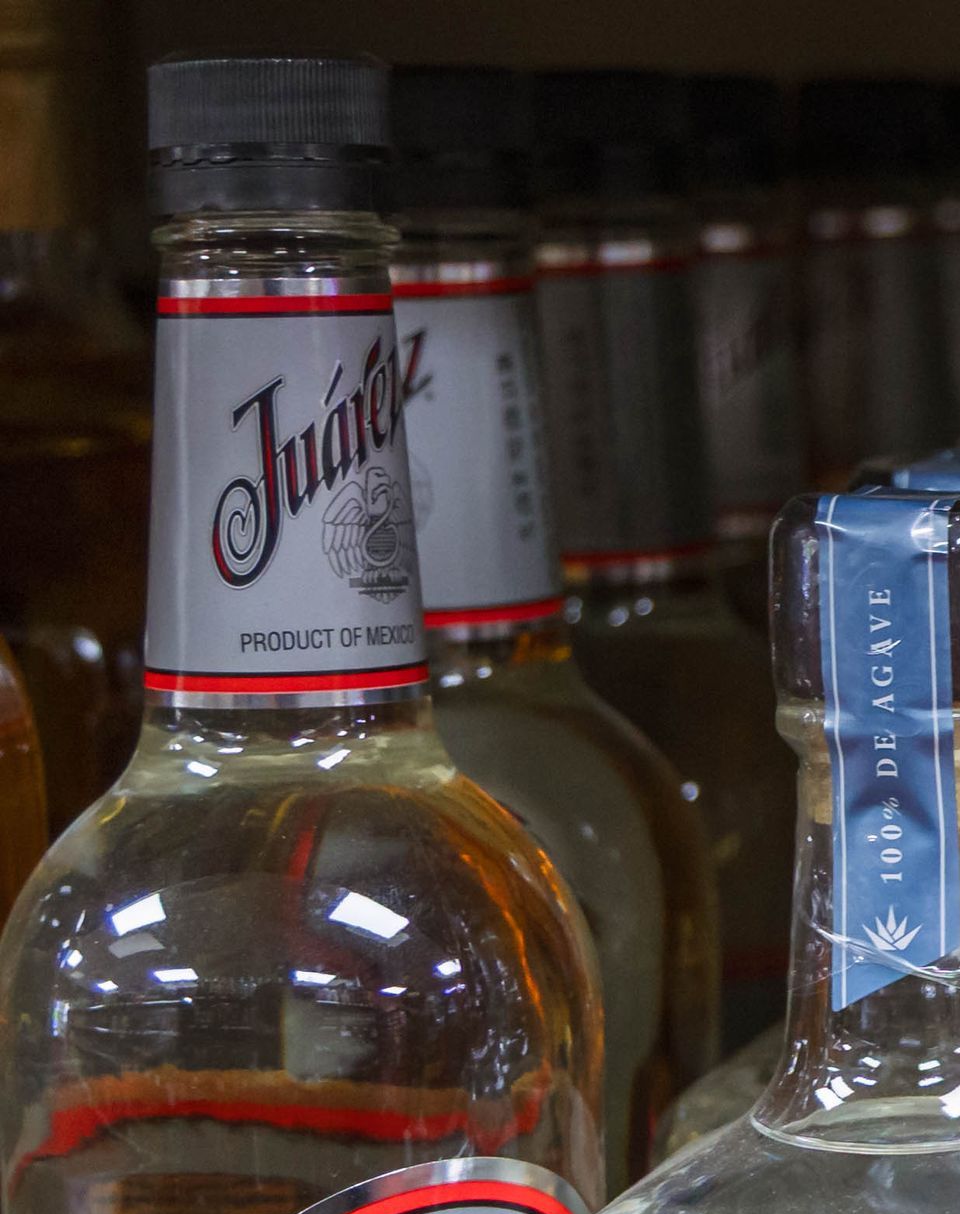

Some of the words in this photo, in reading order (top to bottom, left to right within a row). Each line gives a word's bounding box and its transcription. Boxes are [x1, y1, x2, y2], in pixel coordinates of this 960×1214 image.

[212, 334, 402, 588] Juáre
[240, 629, 334, 653] PRODUCT
[341, 629, 364, 649] OF
[367, 623, 415, 648] MEXICO
[868, 587, 895, 714] AGAVE
[876, 733, 898, 778] DE
[879, 796, 904, 883] 100%
